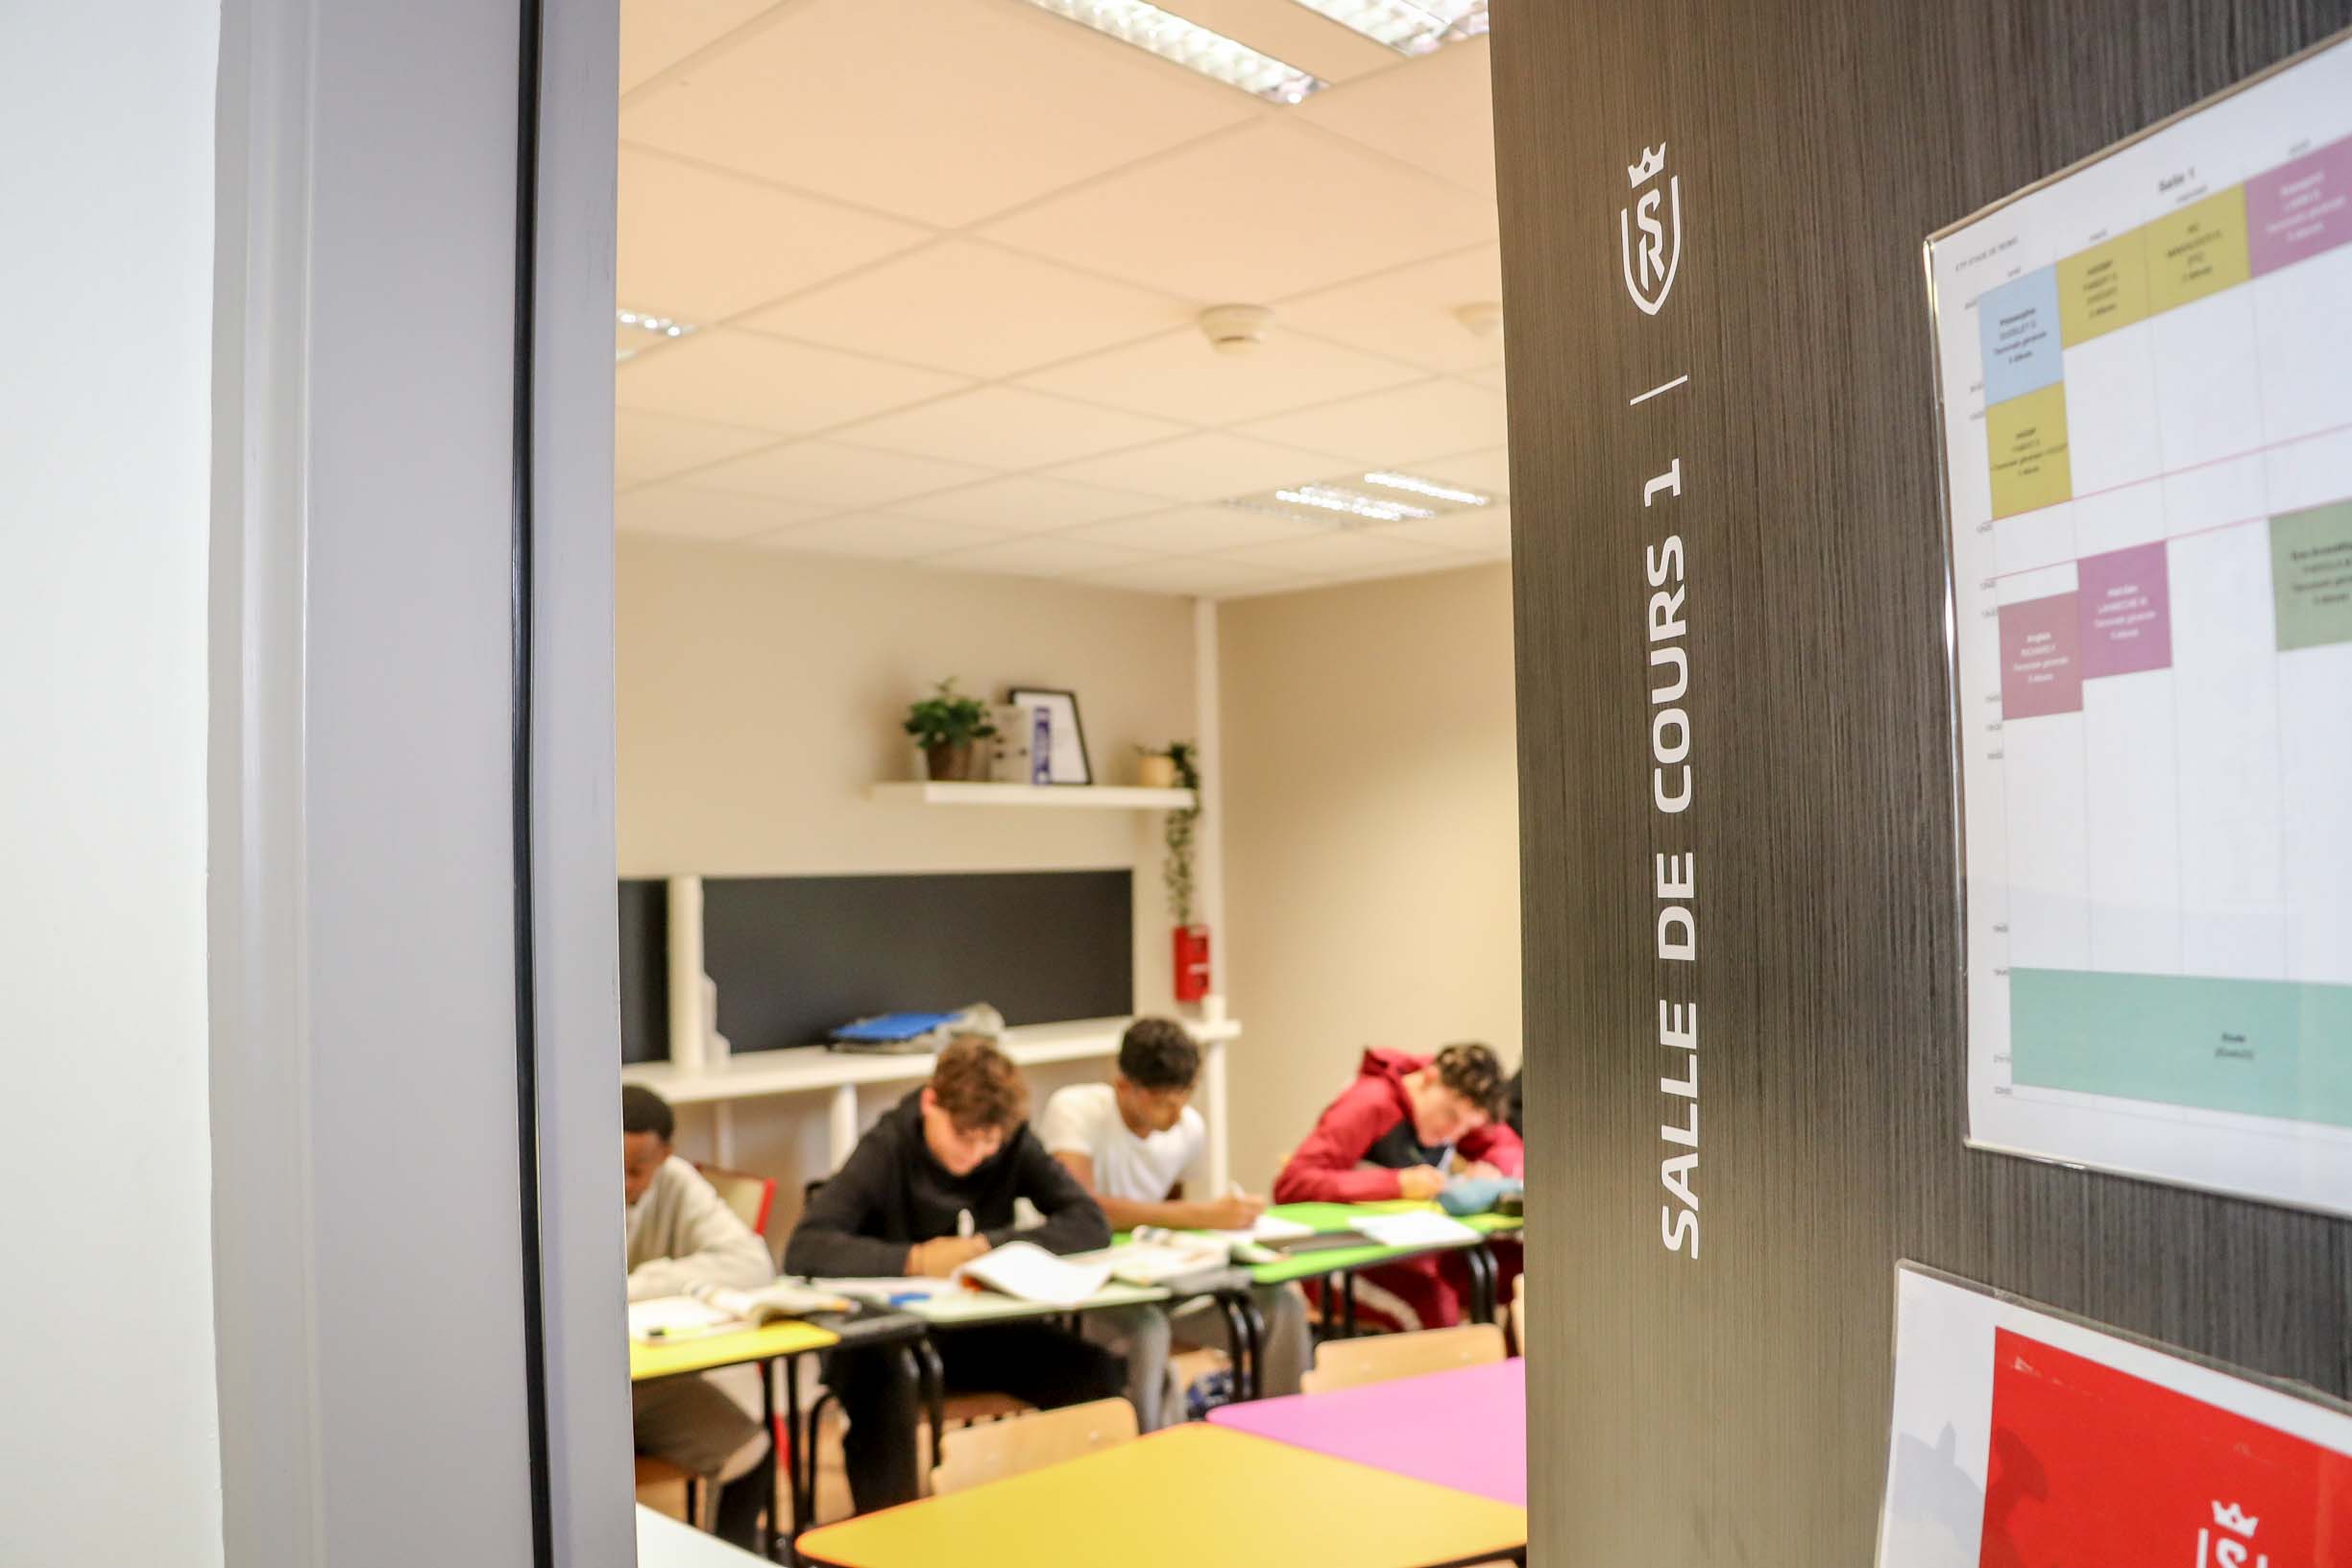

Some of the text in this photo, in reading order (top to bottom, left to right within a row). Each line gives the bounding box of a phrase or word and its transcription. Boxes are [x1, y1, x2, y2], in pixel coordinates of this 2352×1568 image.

[1643, 458, 1699, 1260] SALLE DE COURS 1
